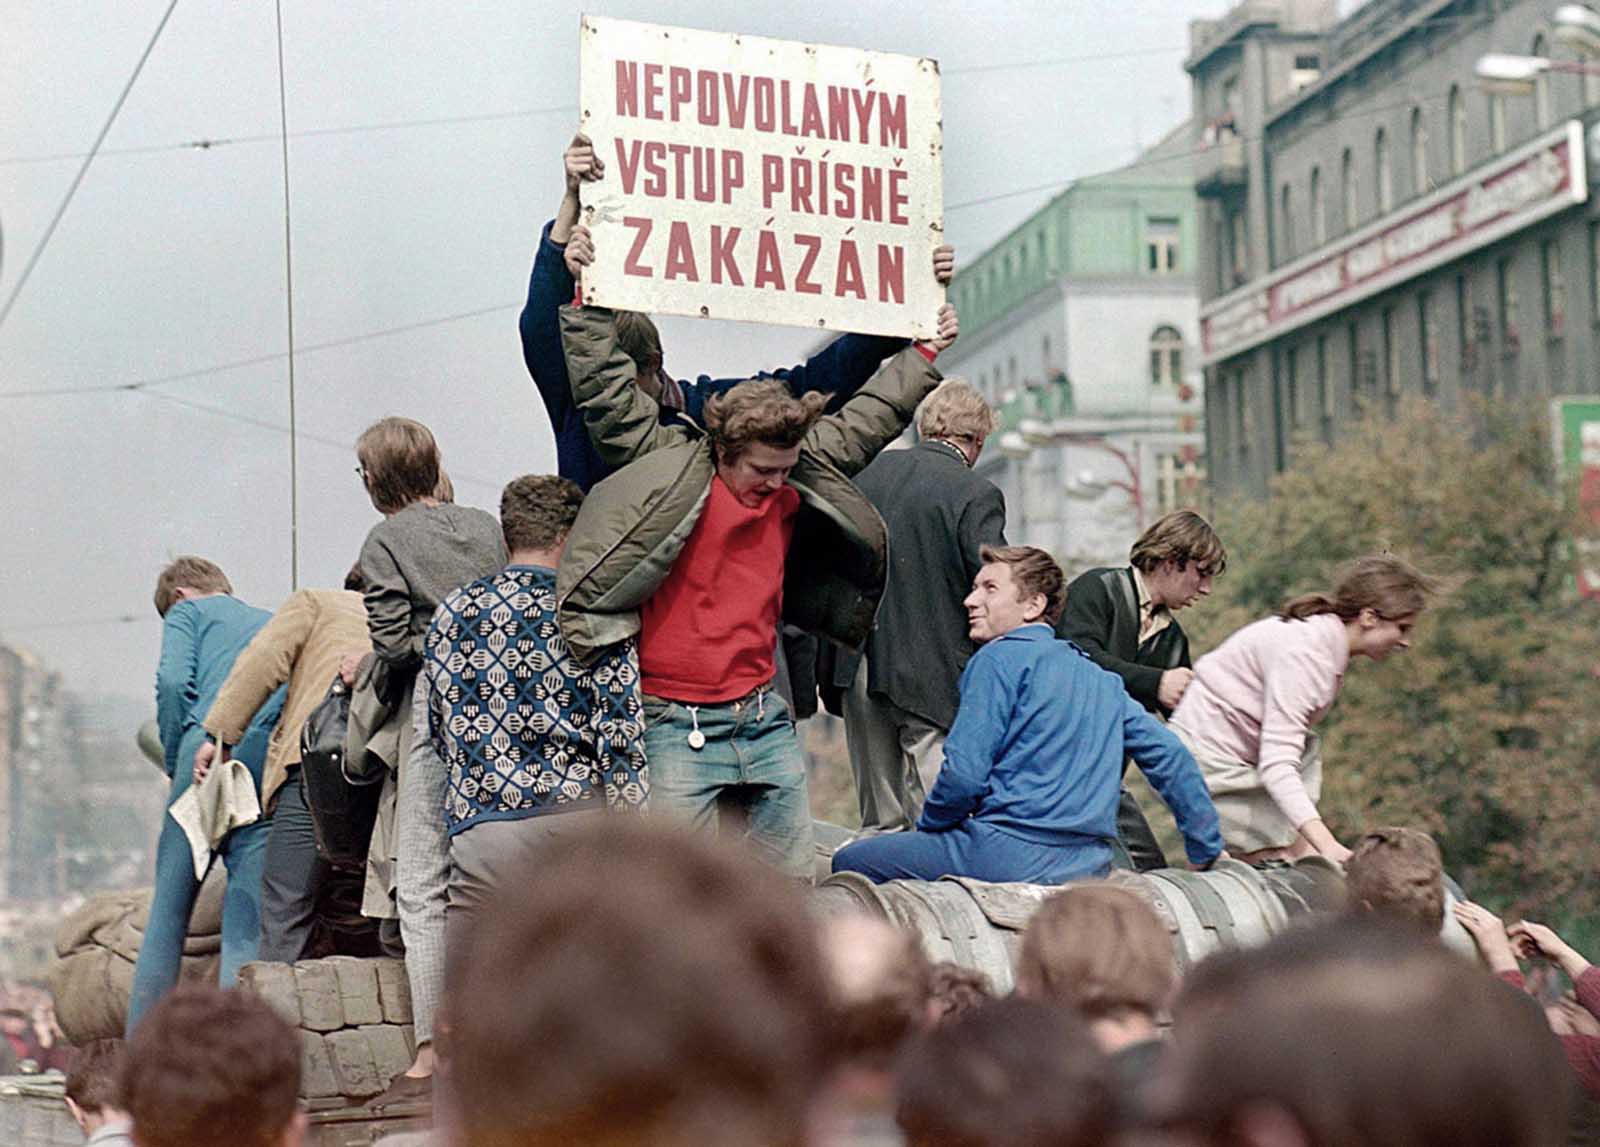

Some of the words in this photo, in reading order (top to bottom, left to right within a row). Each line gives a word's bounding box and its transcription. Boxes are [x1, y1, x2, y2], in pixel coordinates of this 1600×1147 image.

[615, 60, 908, 149] NEPOVOLANÝM
[615, 138, 744, 204] VSTUP
[762, 146, 909, 225] PŘÍSNĚ
[623, 217, 905, 304] ZAKÁZÁN
